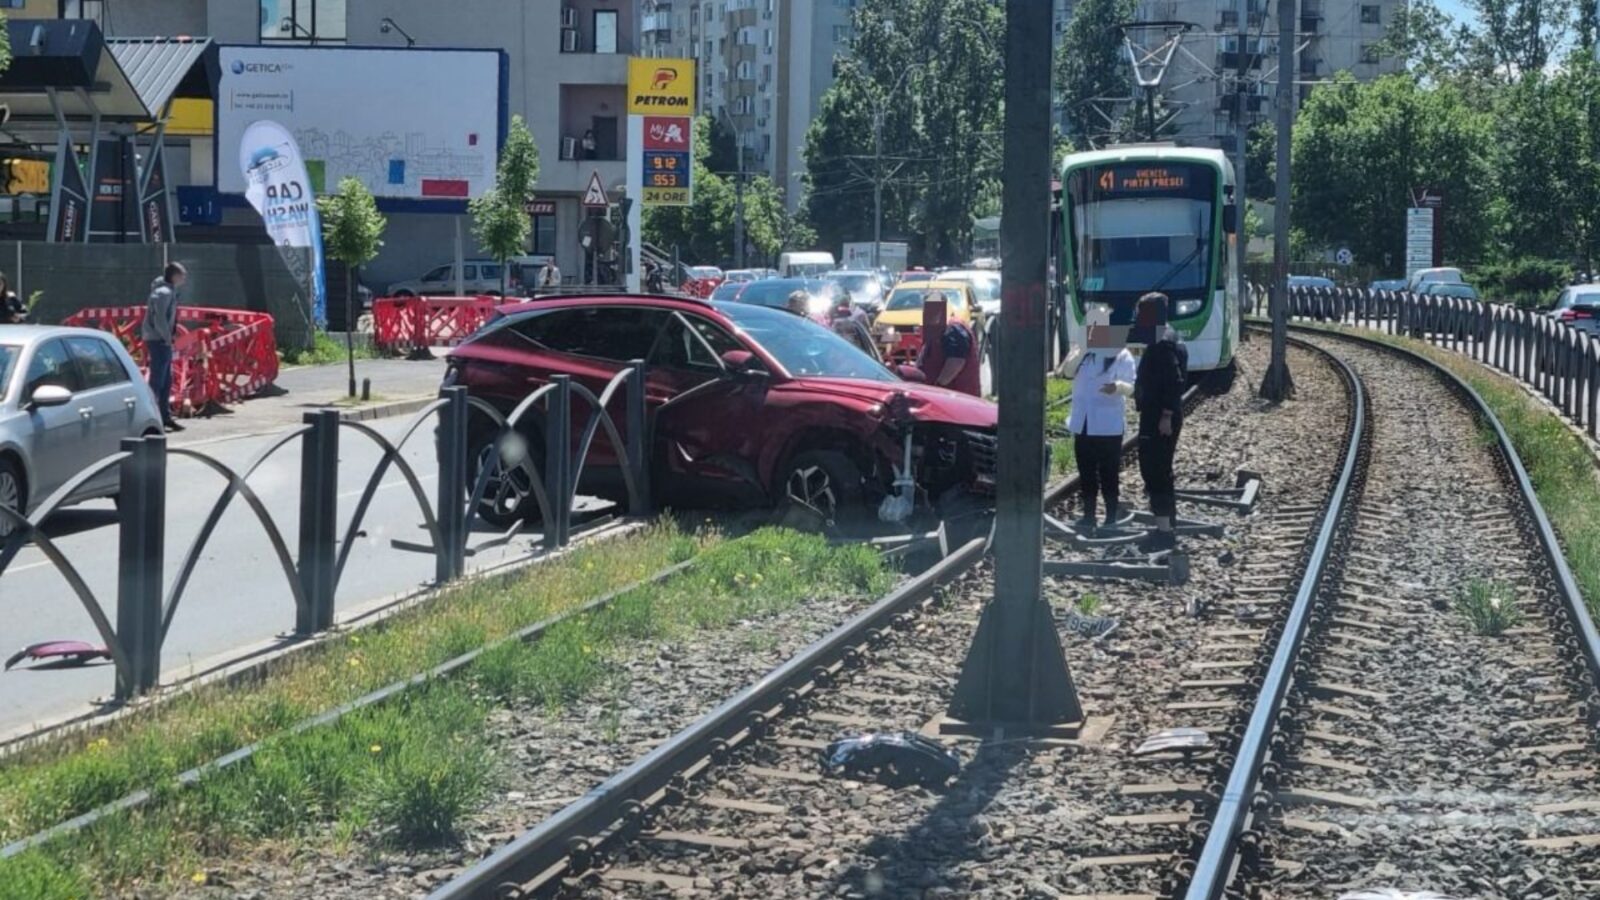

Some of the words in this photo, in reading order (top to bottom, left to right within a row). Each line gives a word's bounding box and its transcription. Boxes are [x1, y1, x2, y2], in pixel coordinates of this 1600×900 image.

[246, 64, 281, 72] GETICA
[634, 95, 689, 106] PETROM
[1100, 170, 1114, 189] 41
[646, 191, 660, 201] 24
[663, 191, 687, 201] ORE
